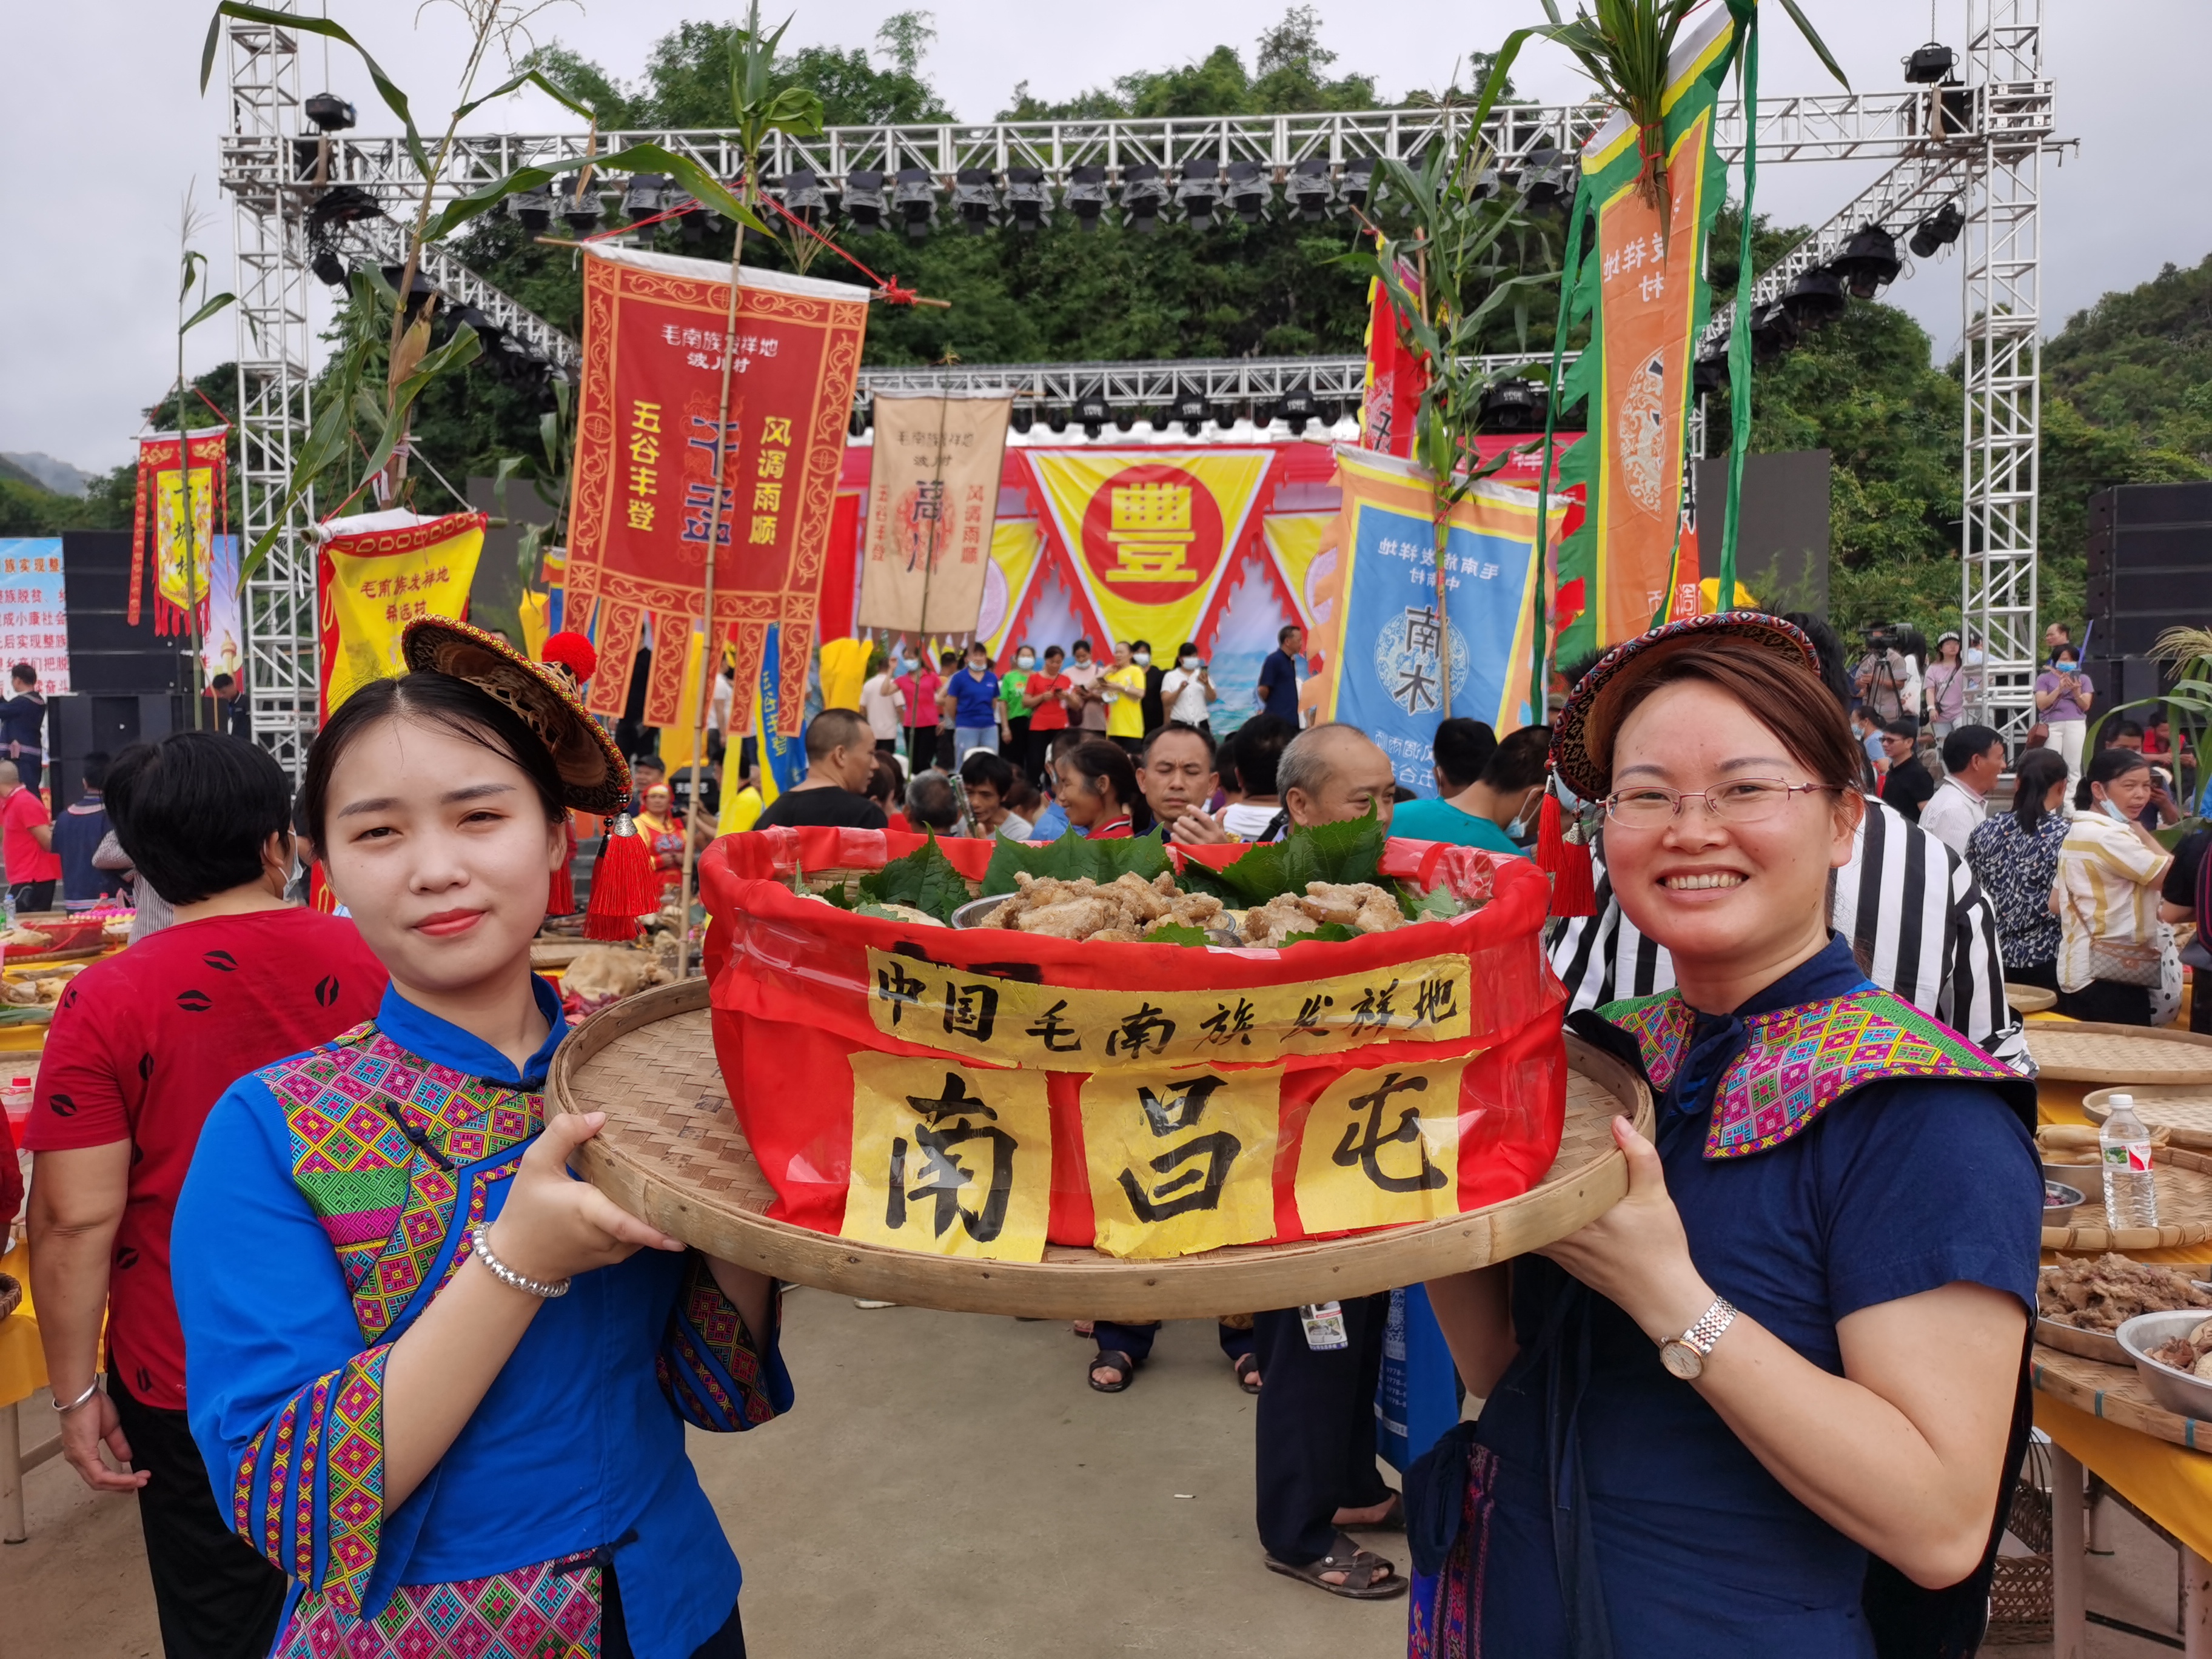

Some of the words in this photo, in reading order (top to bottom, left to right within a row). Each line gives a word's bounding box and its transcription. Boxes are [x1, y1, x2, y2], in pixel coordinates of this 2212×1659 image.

[661, 323, 779, 358] 毛南族发祥地
[686, 352, 751, 374] 波川村
[627, 400, 662, 532] 五谷丰登
[748, 416, 792, 545] 风调雨顺
[960, 484, 984, 564] 风调雨顺
[360, 566, 450, 598] 毛南族发祥地
